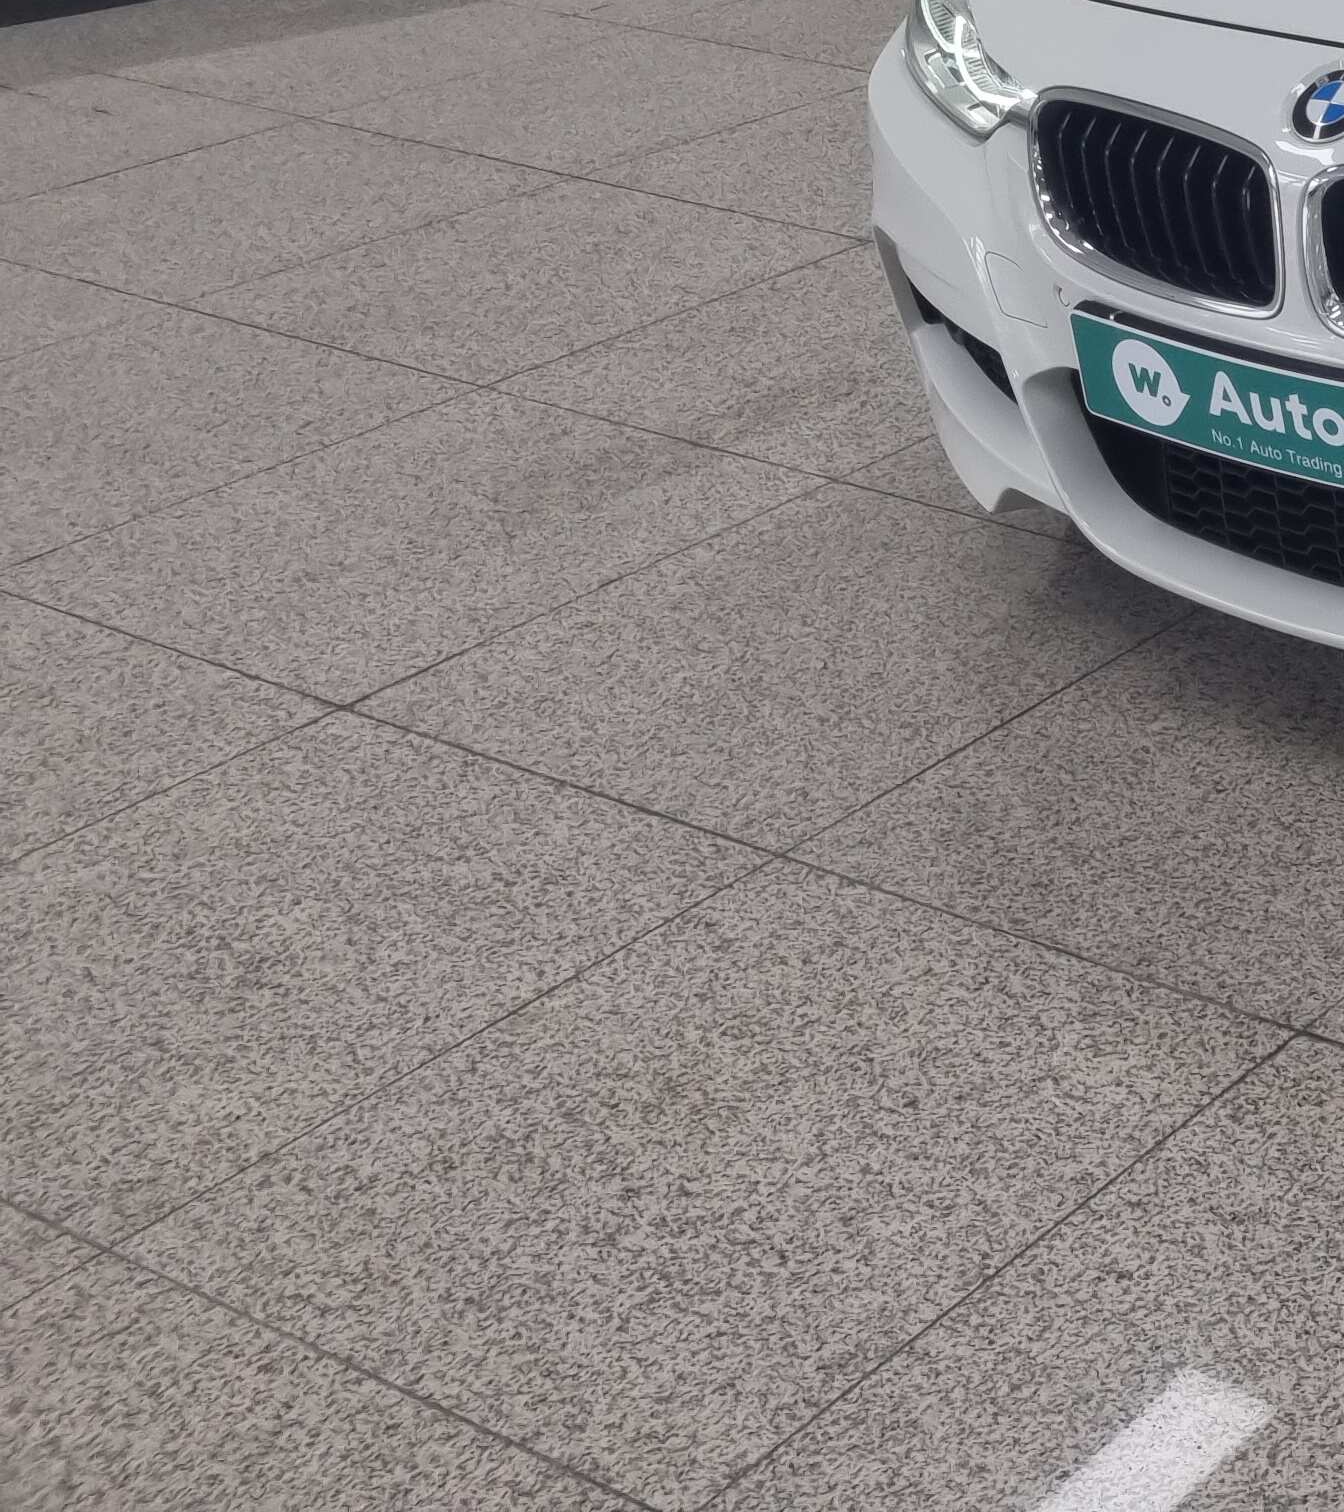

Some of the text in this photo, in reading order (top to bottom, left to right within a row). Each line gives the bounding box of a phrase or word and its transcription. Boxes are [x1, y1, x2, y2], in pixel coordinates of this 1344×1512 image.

[1211, 429, 1244, 450] No.1
[1250, 440, 1283, 461] Auto
[1287, 450, 1343, 479] Trading
